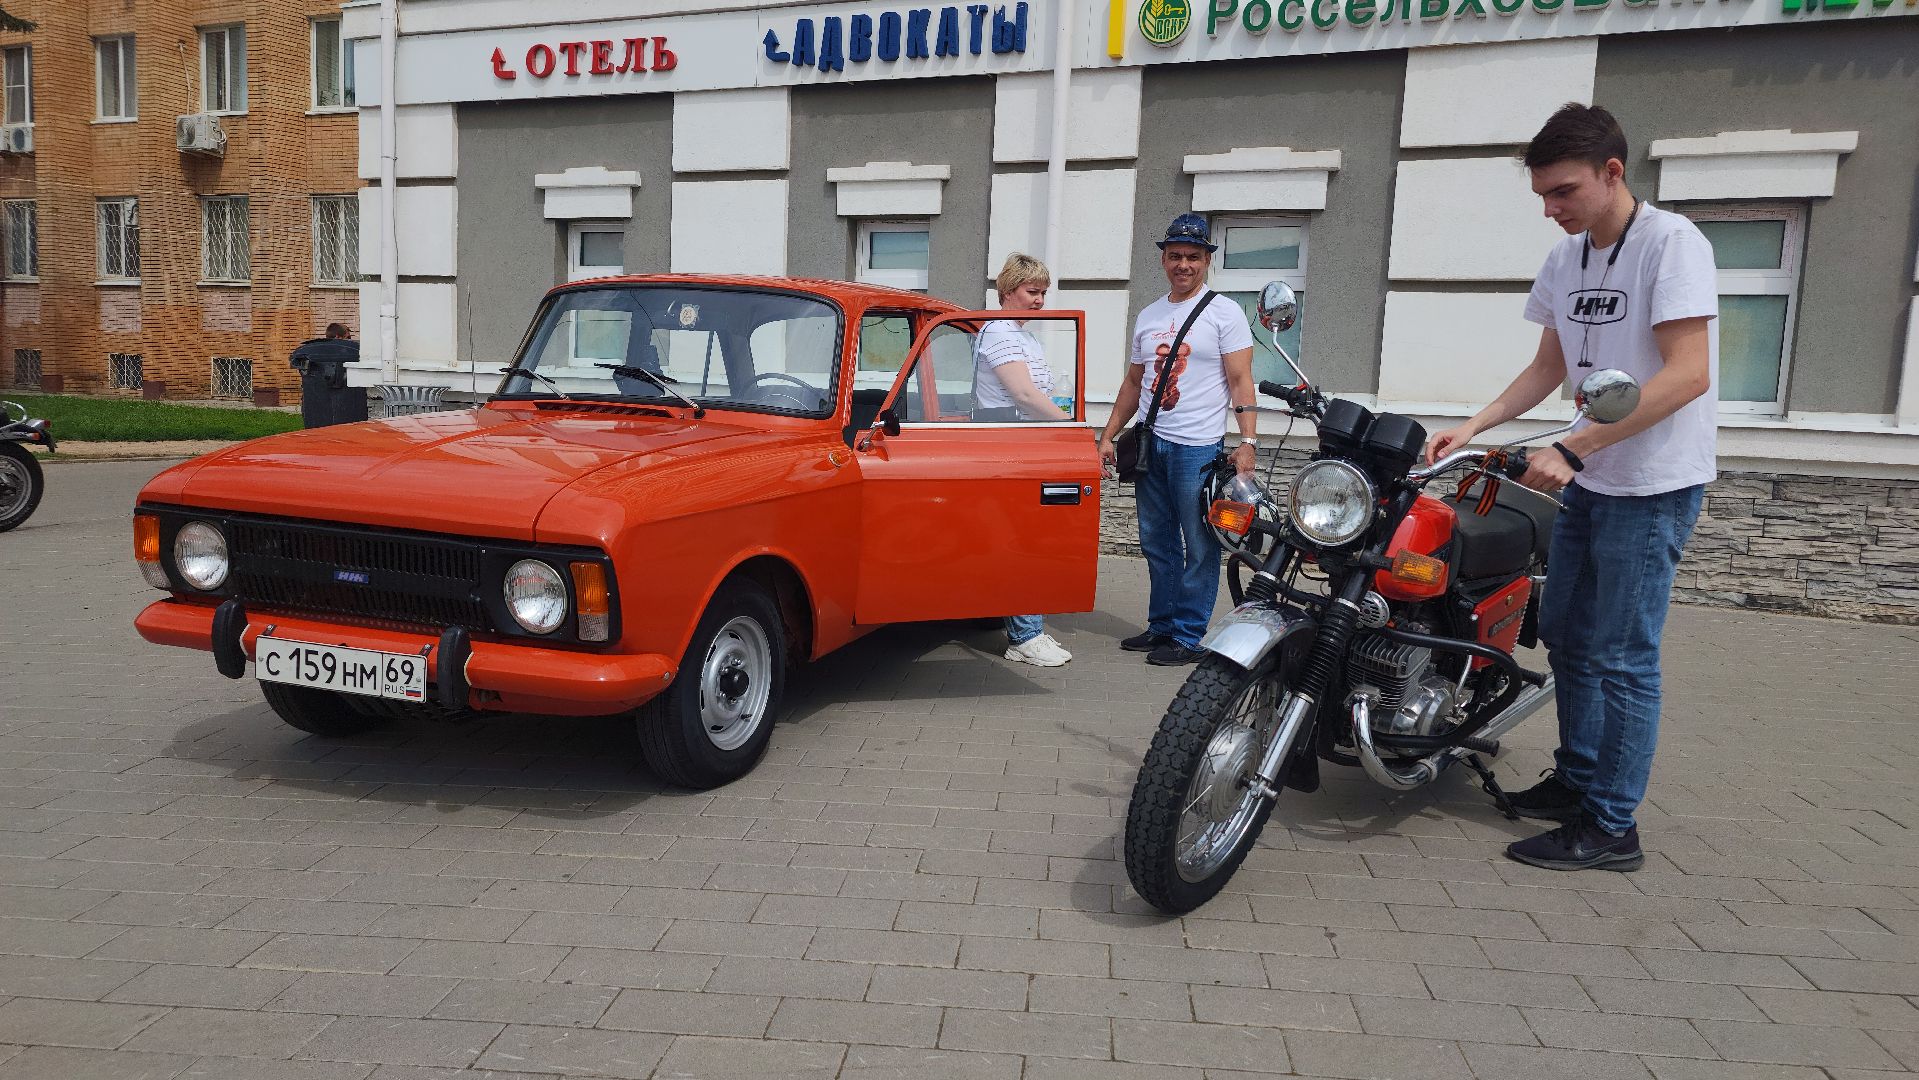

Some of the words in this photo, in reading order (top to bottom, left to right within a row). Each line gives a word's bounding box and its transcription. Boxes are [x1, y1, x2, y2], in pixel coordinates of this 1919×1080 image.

[791, 1, 1029, 72] АДВОКАТЫ
[525, 36, 678, 78] ОТЕЛЬ
[385, 657, 415, 685] 69
[384, 683, 405, 695] RUS
